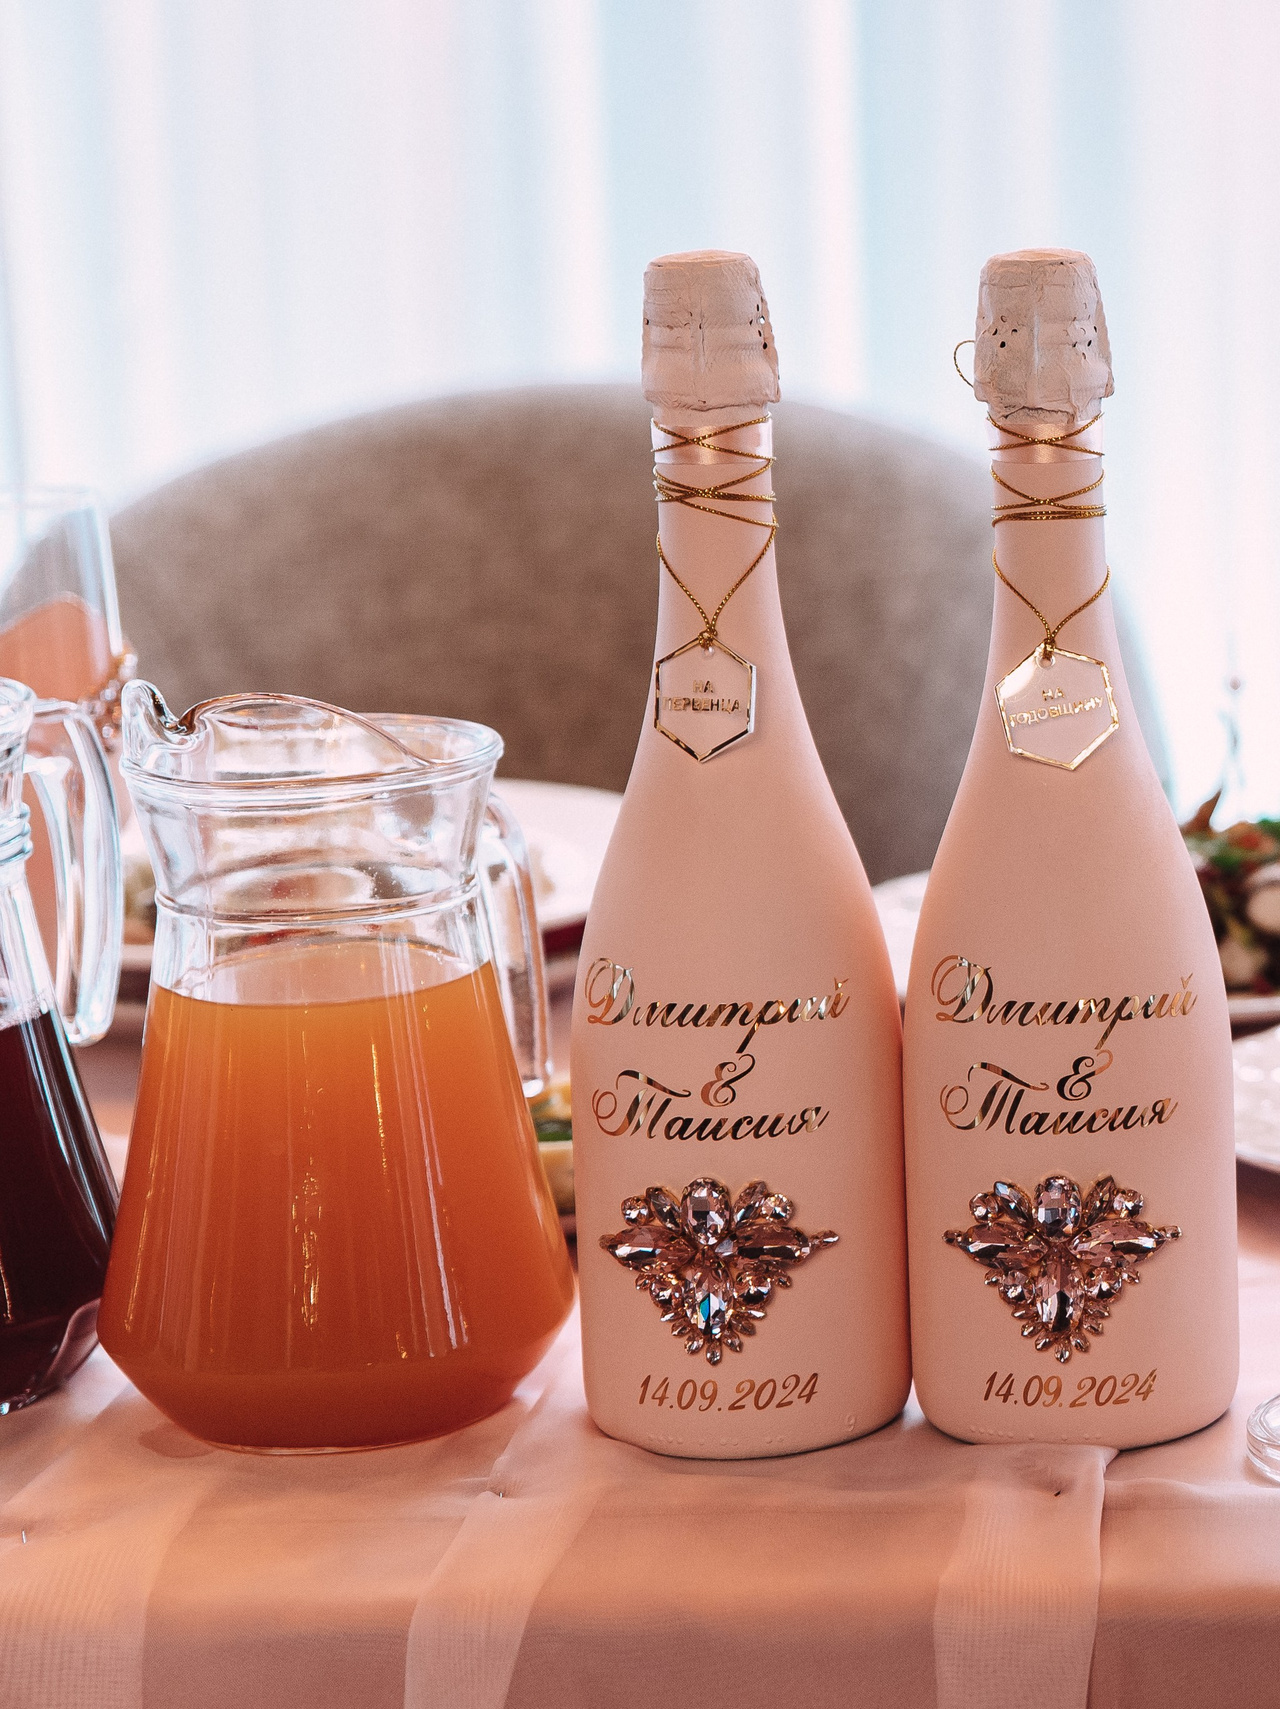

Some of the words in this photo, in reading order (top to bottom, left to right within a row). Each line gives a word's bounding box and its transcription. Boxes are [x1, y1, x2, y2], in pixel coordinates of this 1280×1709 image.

[662, 697, 741, 714] ПЕРВЕНЦА
[692, 680, 714, 693] НА
[1042, 686, 1065, 701] НА
[1008, 696, 1104, 728] ГОДОВЩИНУ
[584, 957, 850, 1054] Дмитрий
[930, 954, 1198, 1051] Дмитрий
[700, 1053, 756, 1108] &
[1056, 1049, 1114, 1101] &
[591, 1069, 830, 1142] Таисия
[939, 1061, 1179, 1136] Таисия
[637, 1372, 819, 1412] 14.09.2024
[983, 1368, 1158, 1409] 14.09.2024
